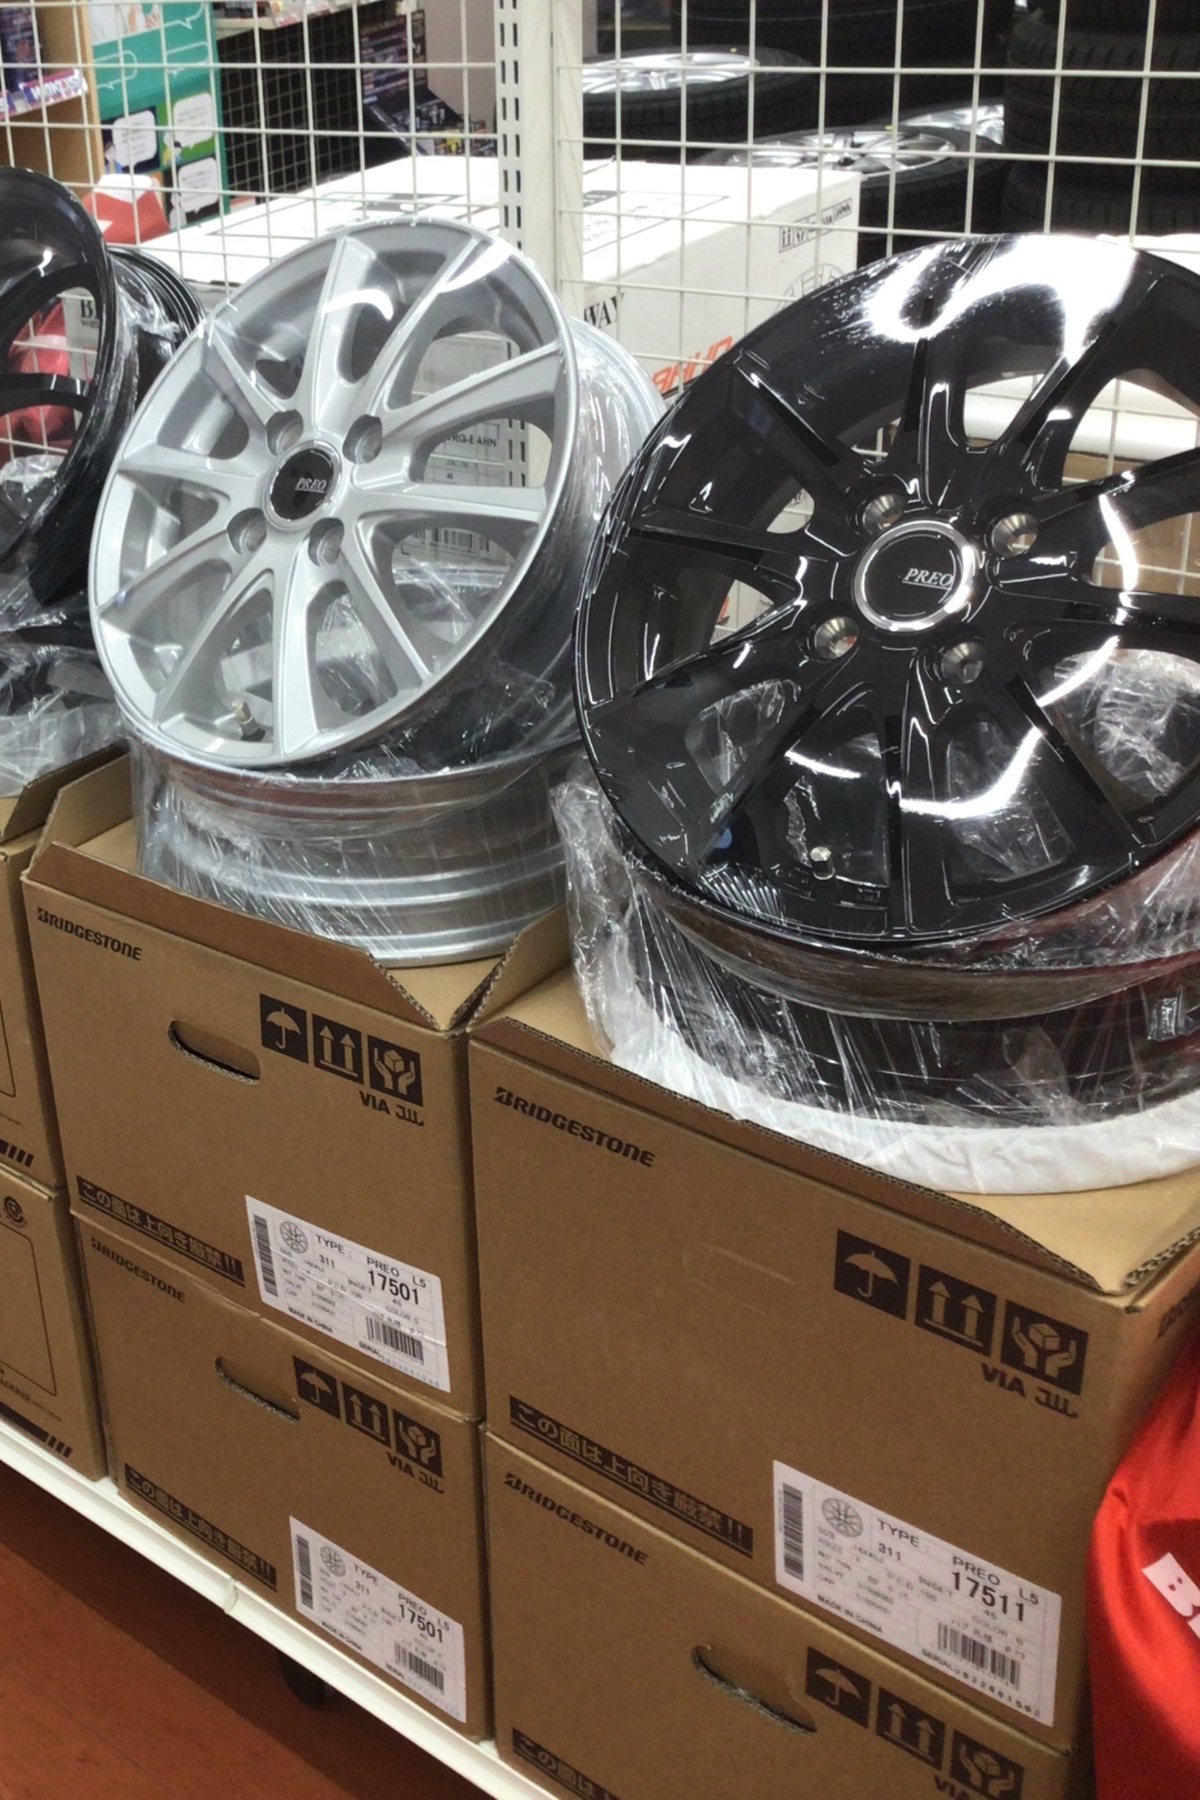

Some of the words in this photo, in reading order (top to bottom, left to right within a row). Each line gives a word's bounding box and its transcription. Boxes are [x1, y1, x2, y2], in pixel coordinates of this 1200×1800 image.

[296, 477, 327, 490] PREO
[902, 567, 954, 588] PREO
[37, 906, 142, 962] BRIDGESTONE
[358, 1089, 391, 1116] VIA
[493, 1086, 656, 1168] BRIDGESTONE
[91, 1237, 186, 1303] BRIDGESTONE
[315, 1235, 344, 1254] TYPE
[366, 1256, 399, 1278] PREO
[412, 1276, 426, 1289] L5
[318, 1254, 335, 1268] 311
[367, 1268, 419, 1306] 17501
[981, 1362, 1026, 1398] VIA
[386, 1452, 415, 1478] VIA
[504, 1471, 649, 1565] BRIDGESTONE
[878, 1519, 919, 1548] TYPE
[952, 1555, 1000, 1587] PREO
[1019, 1587, 1038, 1606] L5
[878, 1542, 901, 1562] 311
[952, 1569, 1025, 1623] 17511
[353, 1563, 380, 1585] TYPE
[398, 1593, 428, 1616] PREO
[1140, 1551, 1200, 1636] B
[399, 1604, 444, 1643] 17501
[855, 1613, 882, 1633] CHINA
